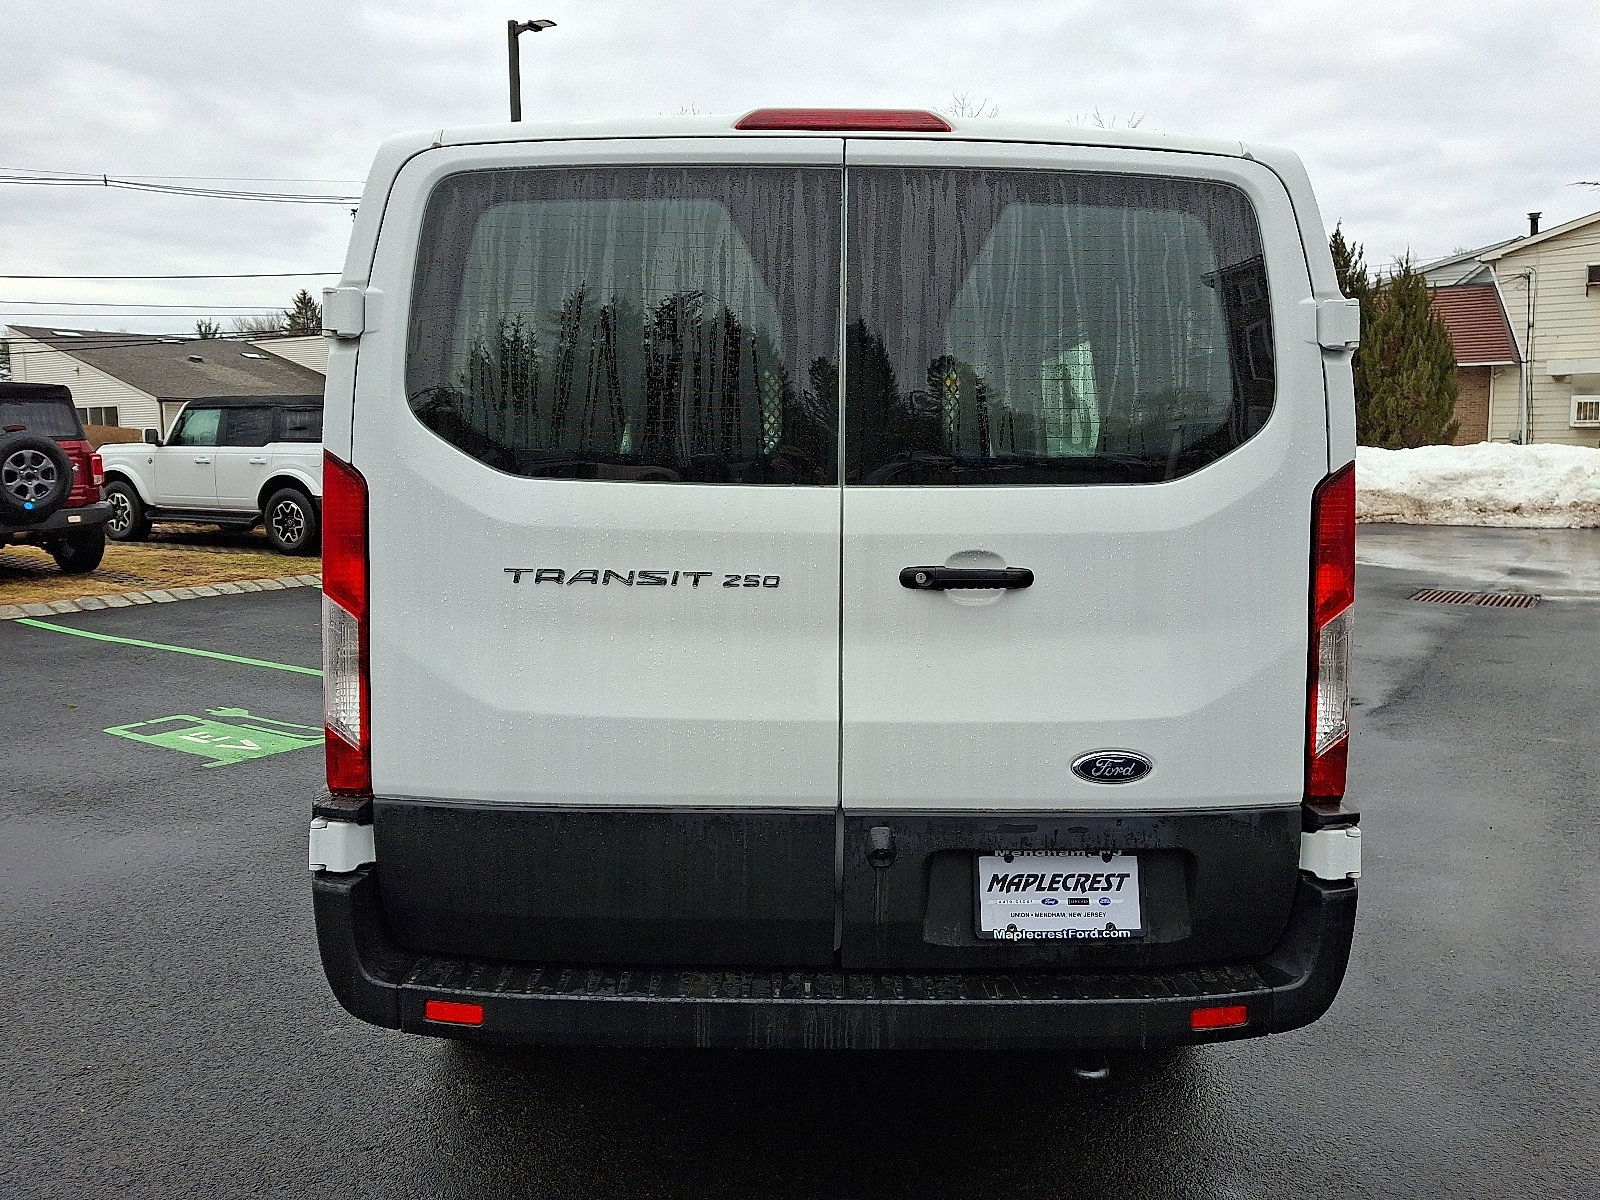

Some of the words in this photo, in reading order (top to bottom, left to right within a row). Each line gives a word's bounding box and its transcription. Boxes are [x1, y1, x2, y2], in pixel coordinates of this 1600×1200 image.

[503, 568, 713, 588] TRANSIT
[722, 574, 781, 588] 250
[178, 731, 263, 751] EV
[1091, 758, 1136, 777] Ford
[986, 872, 1131, 894] MAPLECREST
[993, 929, 1131, 941] MaplecrestFord.com
